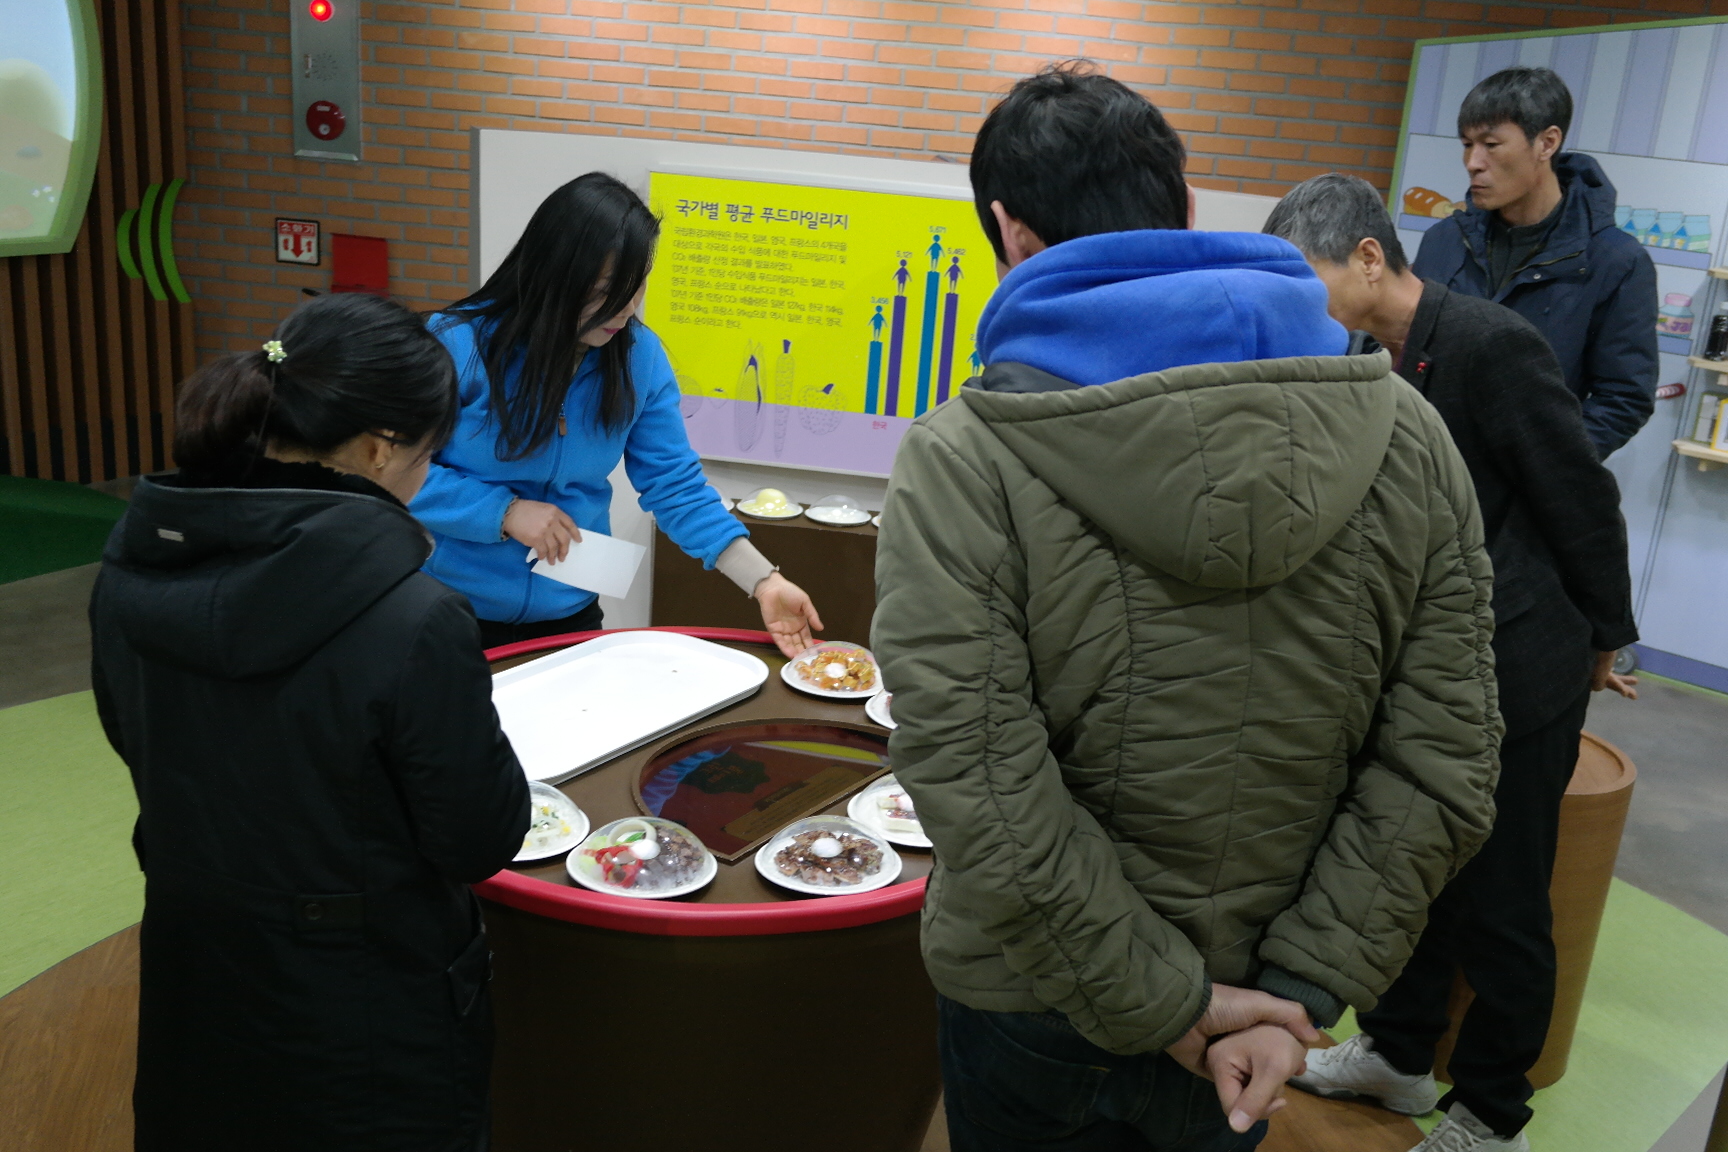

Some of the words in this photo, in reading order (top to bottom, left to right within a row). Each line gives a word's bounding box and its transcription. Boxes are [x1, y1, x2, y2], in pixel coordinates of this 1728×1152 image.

[676, 199, 719, 220] 국가별
[725, 204, 755, 223] 평균
[760, 207, 848, 230] 푸드마일리지
[281, 223, 314, 234] 소화기
[673, 239, 702, 250] 대상으로
[791, 250, 837, 263] 푸드마일리지
[872, 421, 887, 429] 한국
